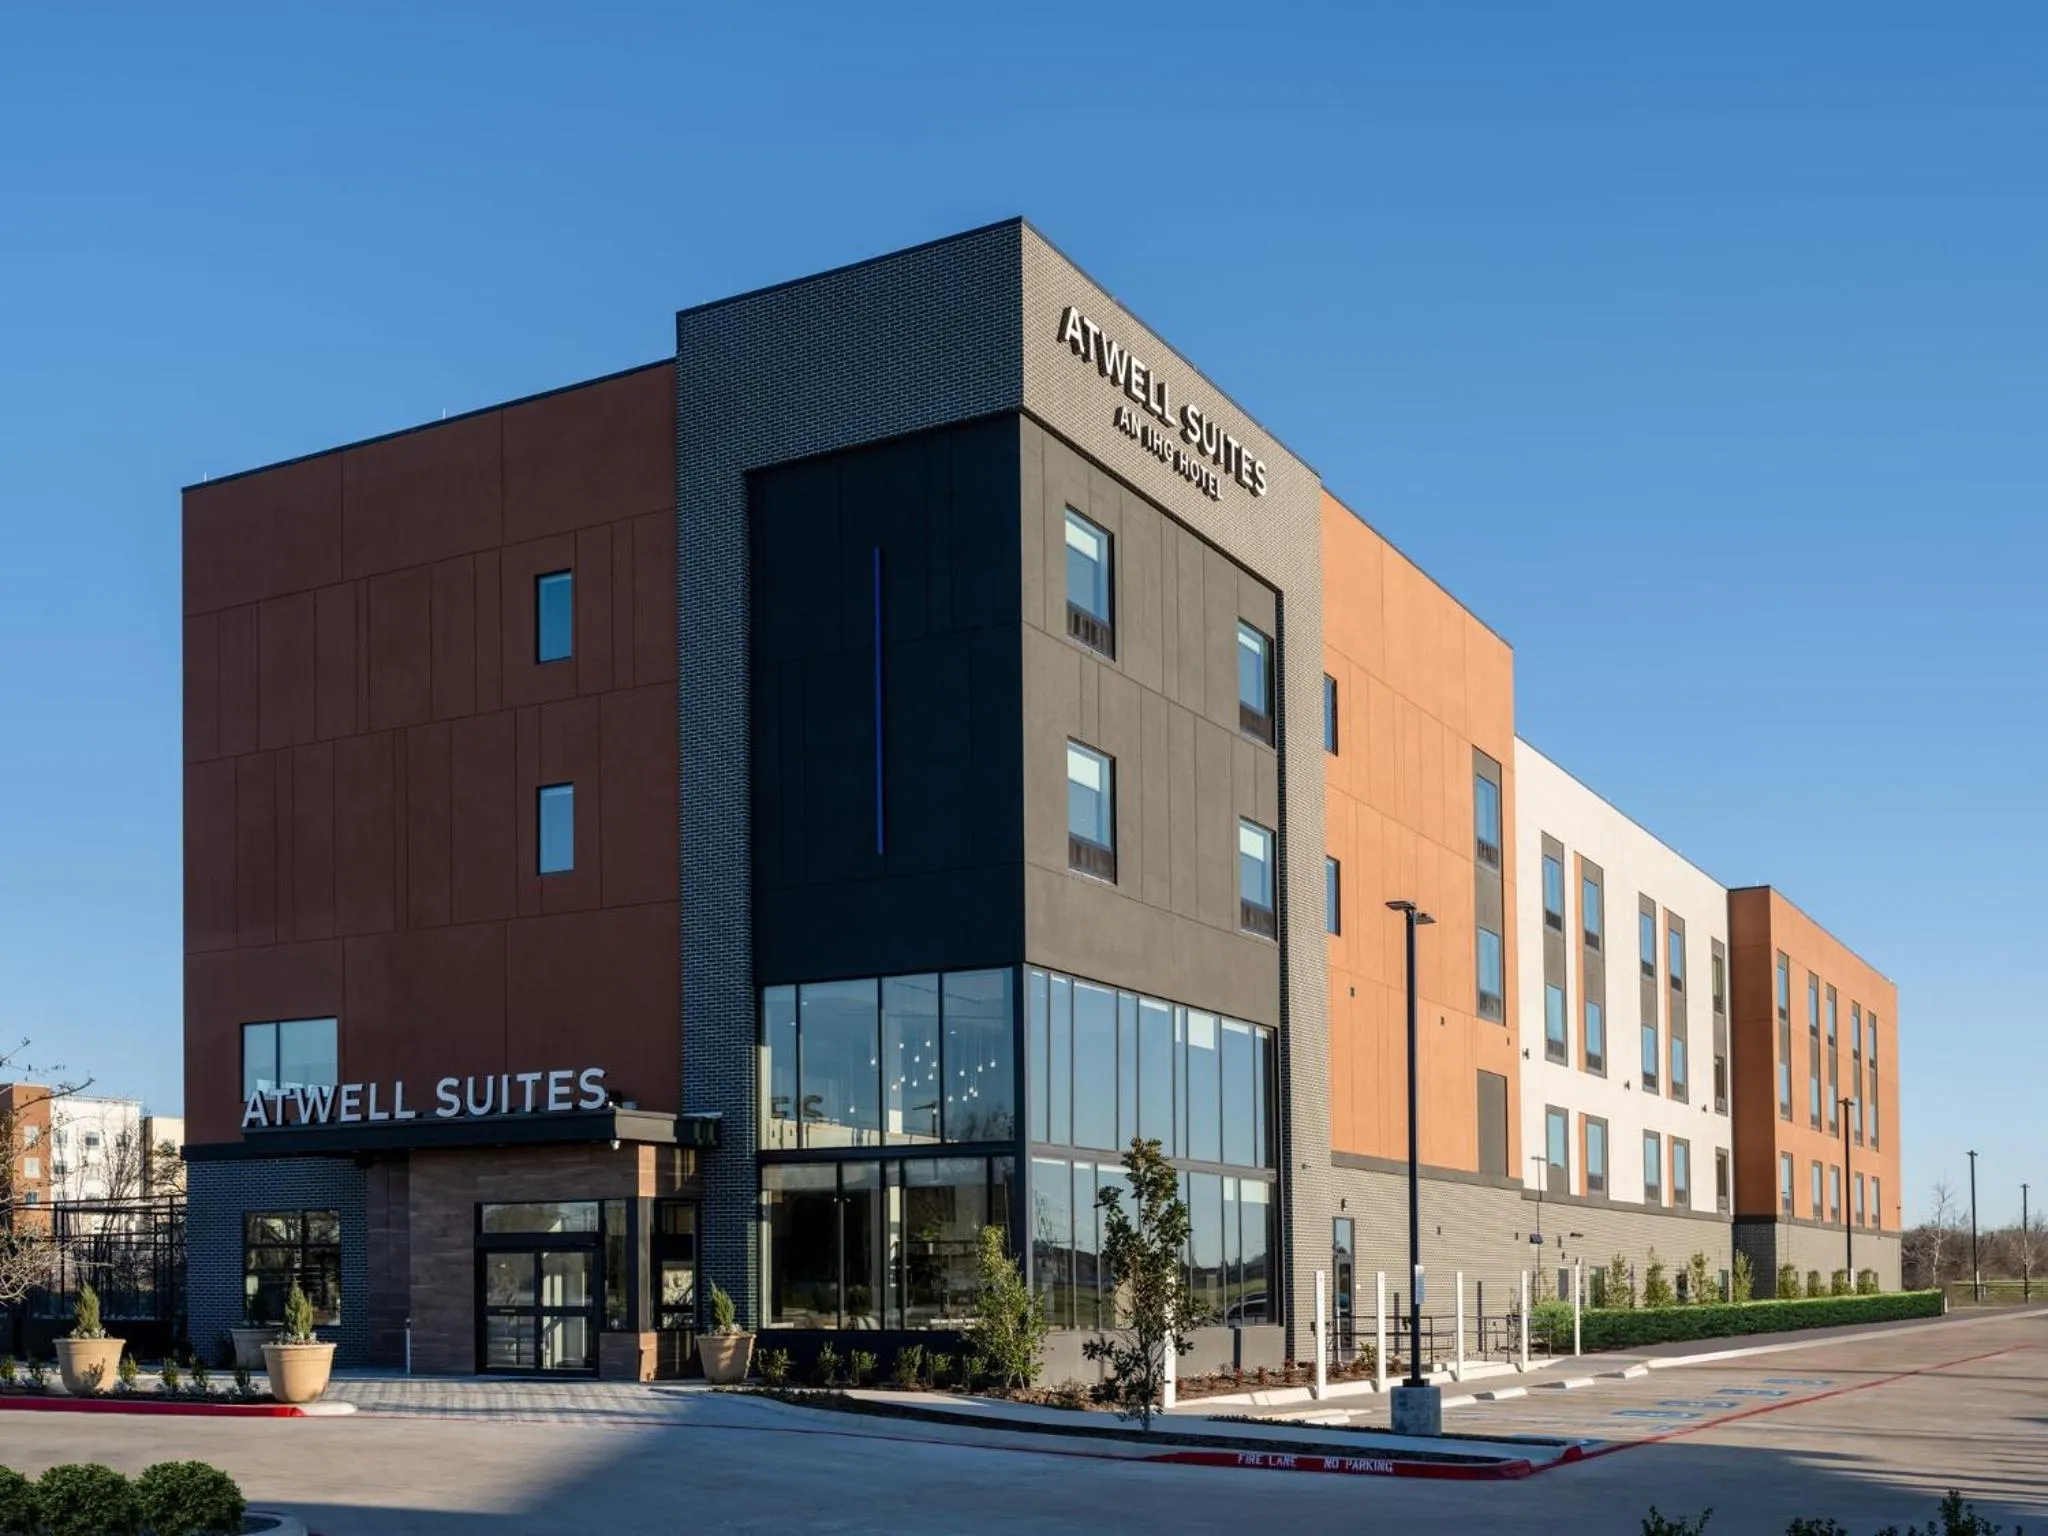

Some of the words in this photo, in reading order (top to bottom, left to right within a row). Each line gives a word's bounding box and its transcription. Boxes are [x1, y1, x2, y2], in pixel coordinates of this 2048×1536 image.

[1060, 306, 1176, 426] ATWELL
[1183, 404, 1267, 497] SUITES
[1116, 406, 1141, 439] AN
[1145, 426, 1173, 462] IHG
[1177, 450, 1223, 500] HOTEL
[241, 1081, 416, 1128] ATWELL
[435, 1067, 607, 1118] SUITES
[1237, 1453, 1263, 1465] FIRE
[1268, 1454, 1296, 1467] LANE
[1323, 1456, 1339, 1469] NO
[1345, 1458, 1394, 1473] PARKING
